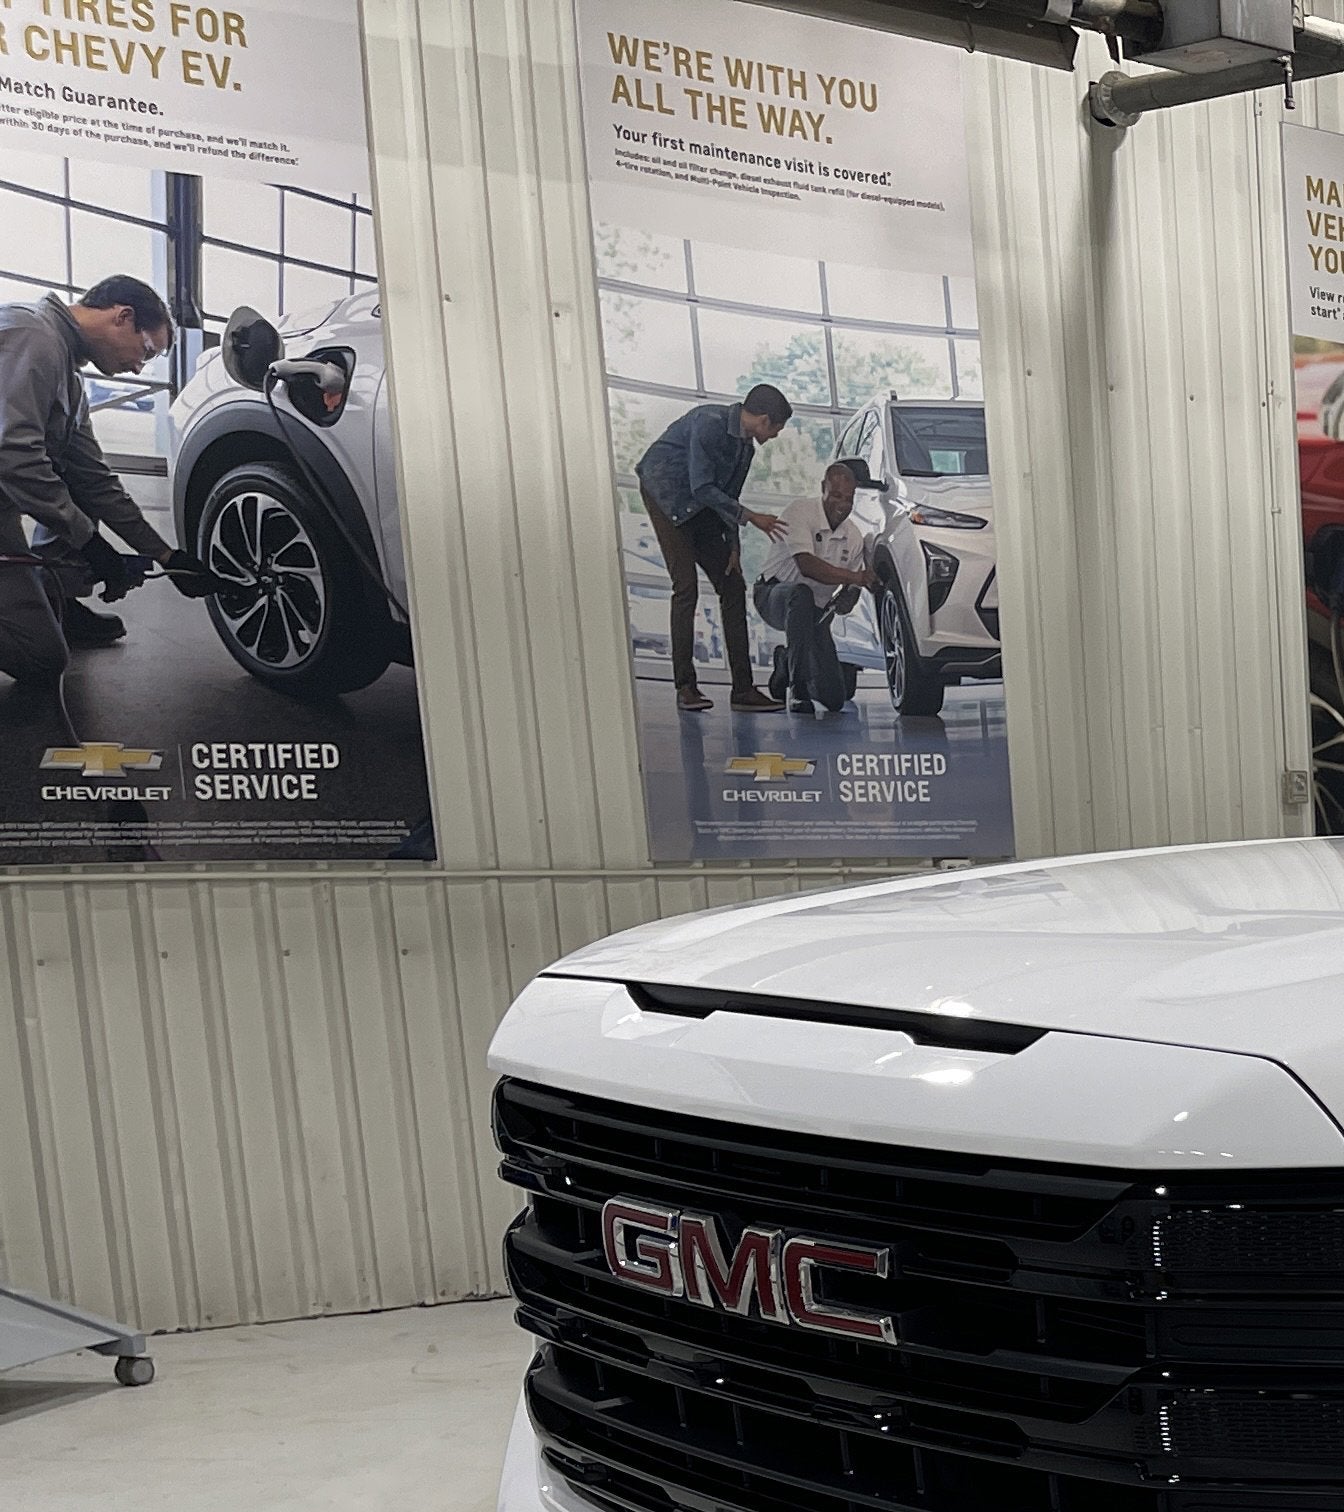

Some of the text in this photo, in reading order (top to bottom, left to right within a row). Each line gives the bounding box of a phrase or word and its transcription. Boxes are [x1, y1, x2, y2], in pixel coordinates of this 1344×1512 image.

[170, 3, 248, 48] FOR
[24, 24, 166, 79] CHEVY
[181, 50, 242, 91] EV.
[607, 31, 879, 113] WE'RE WITH YOU
[0, 75, 164, 115] Match Guarantee.
[611, 74, 833, 145] ALL THE WAY.
[31, 121, 44, 131] 30
[47, 123, 70, 136] days
[72, 128, 82, 136] of
[85, 130, 101, 139] the
[154, 141, 171, 149] and
[197, 145, 229, 157] refund
[231, 150, 246, 159] the
[62, 114, 87, 124] price
[103, 120, 118, 129] the
[122, 122, 143, 132] time
[146, 126, 155, 134] of
[158, 128, 204, 142] purchase,
[207, 135, 223, 144] and
[249, 140, 278, 151] match
[612, 123, 647, 145] Your
[651, 131, 685, 152] first
[689, 140, 781, 170] maintenance
[784, 157, 815, 175] visit
[818, 162, 830, 177] is
[1309, 286, 1334, 302] View
[190, 742, 341, 770] CERTIFIED
[837, 753, 946, 776] CERTIFIED
[41, 785, 172, 801] CHEVROLET
[194, 773, 319, 801] SERVICE
[722, 789, 822, 802] CHEVROLET
[839, 780, 931, 803] SERVICE
[601, 1192, 898, 1346] GMC
